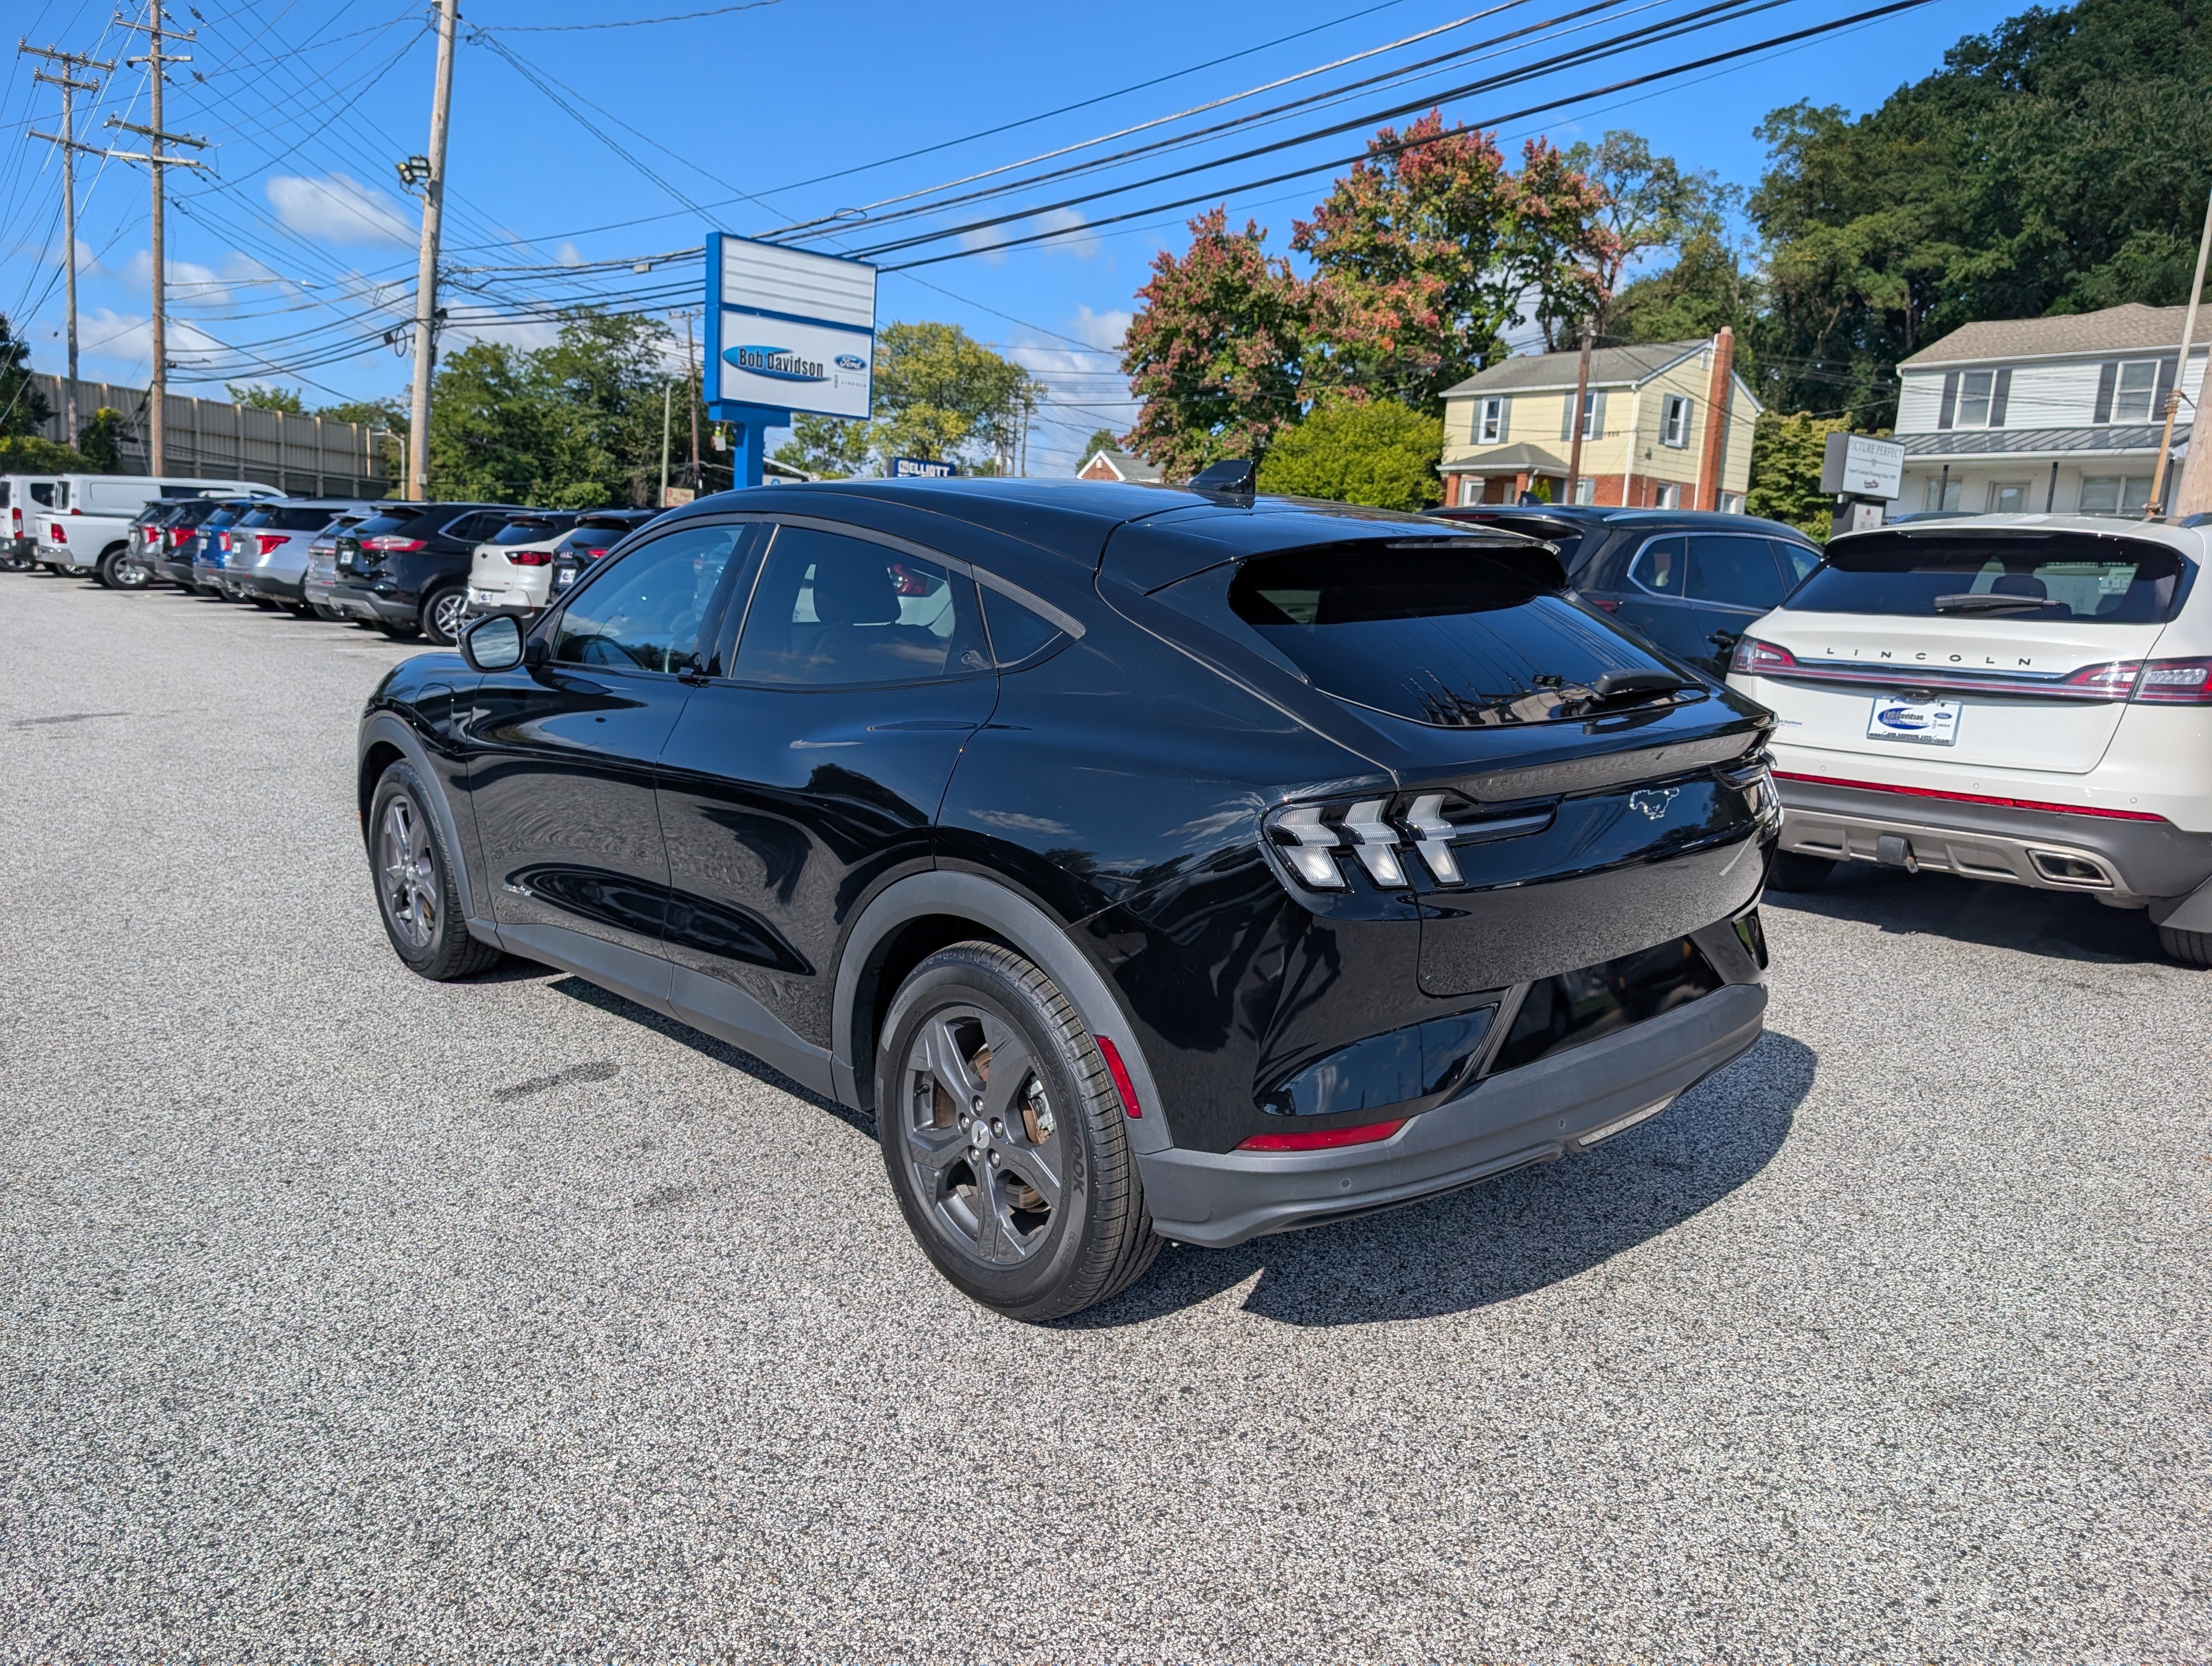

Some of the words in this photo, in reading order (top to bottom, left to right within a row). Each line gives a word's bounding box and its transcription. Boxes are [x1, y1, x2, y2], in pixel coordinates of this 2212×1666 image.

[739, 347, 763, 369] Bob
[767, 352, 825, 378] Davidson
[1875, 445, 1903, 459] PERFECT
[1827, 646, 2031, 666] LINCOLN
[1885, 710, 1896, 719] Bob
[1896, 712, 1924, 721] Davidson
